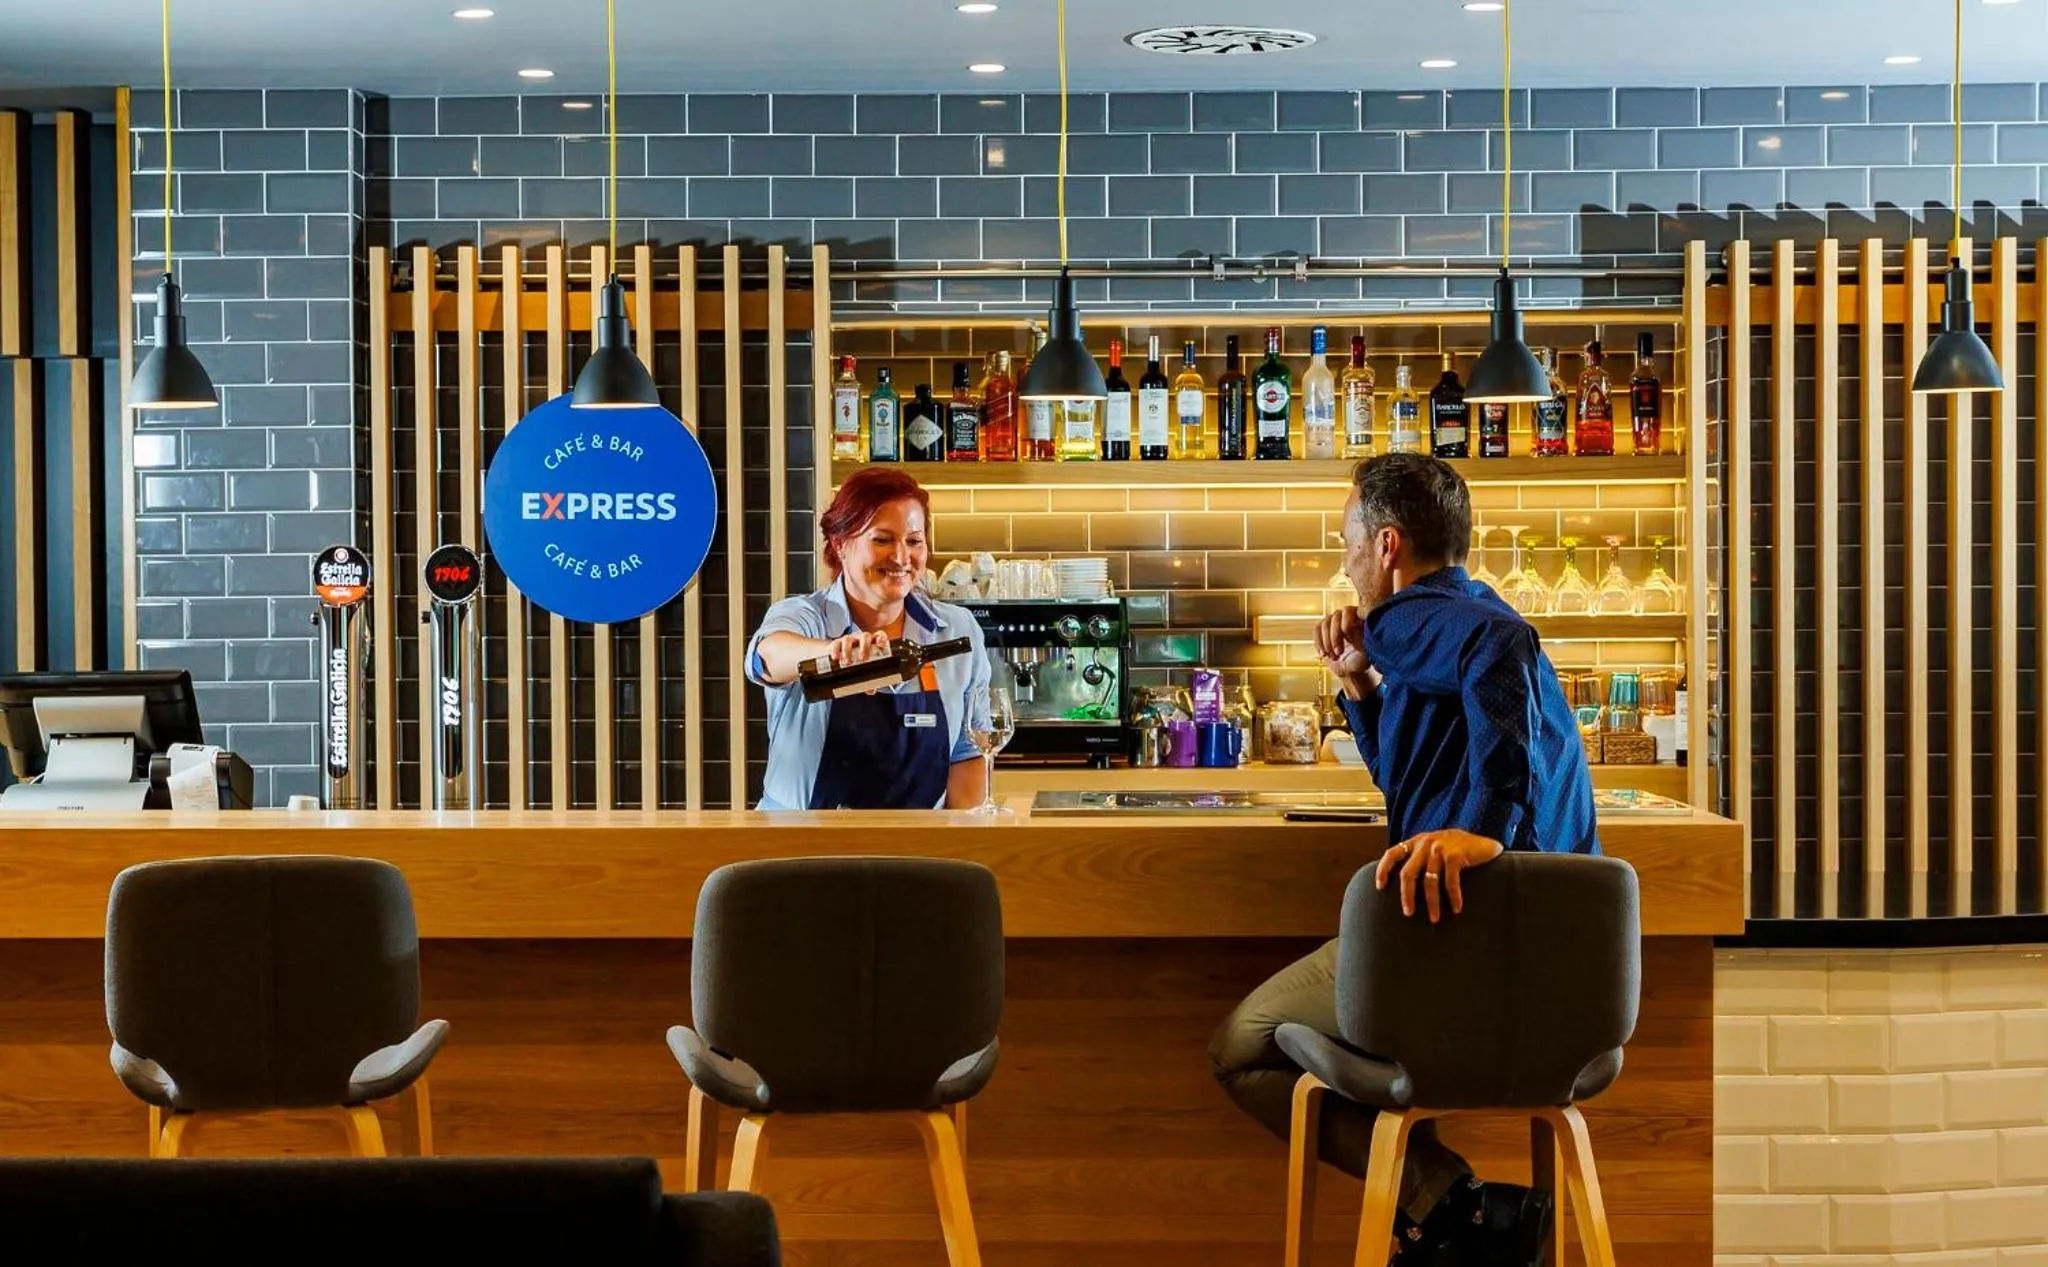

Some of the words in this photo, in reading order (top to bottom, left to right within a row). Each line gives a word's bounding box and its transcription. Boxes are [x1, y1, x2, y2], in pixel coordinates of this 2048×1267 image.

[544, 433, 586, 470] CAFÉ
[591, 434, 603, 449] &
[609, 436, 644, 462] BAR
[522, 492, 677, 520] EXPRESS
[320, 562, 363, 575] Estrella
[433, 565, 471, 583] 1906
[544, 543, 588, 576] CAFÉ
[590, 564, 602, 579] &
[608, 553, 643, 578] BAR
[321, 573, 361, 586] Galicia
[329, 648, 348, 704] Galicia
[441, 676, 461, 726] 1906
[329, 705, 348, 768] Estrella
